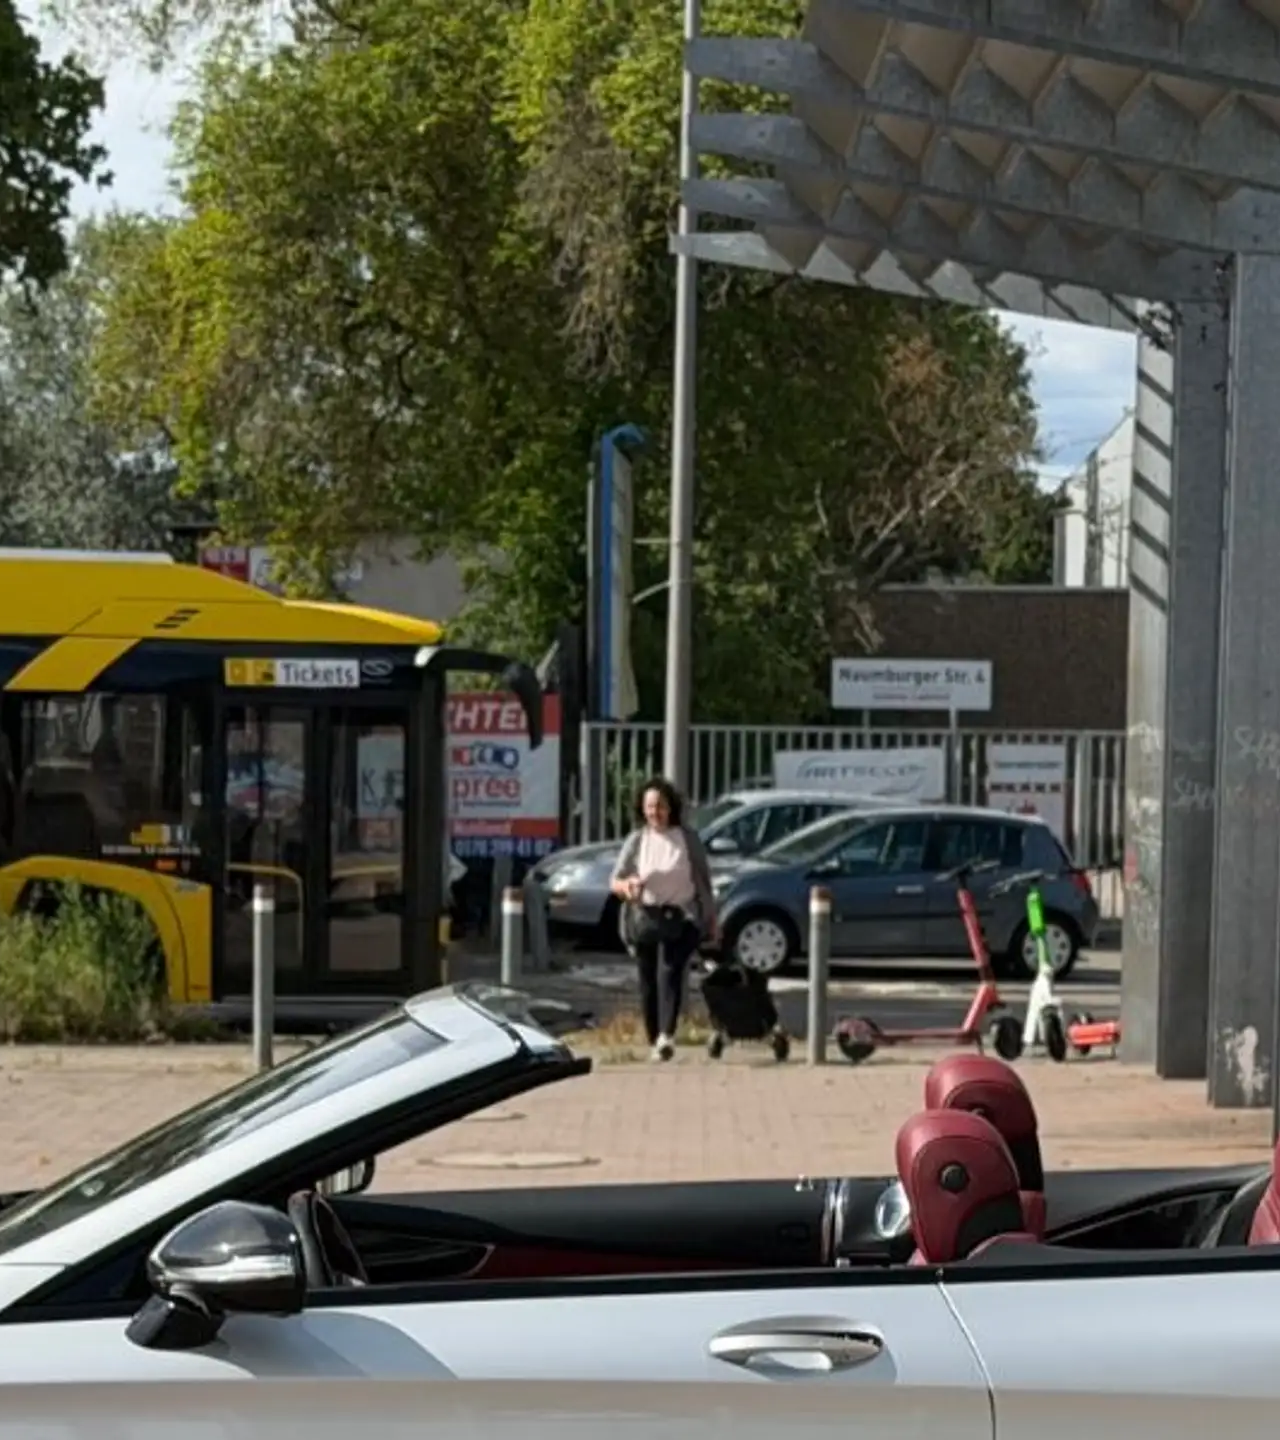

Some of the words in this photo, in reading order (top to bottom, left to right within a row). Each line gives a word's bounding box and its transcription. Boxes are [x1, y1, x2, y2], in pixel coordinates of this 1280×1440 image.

[279, 661, 356, 685] Tickets
[839, 666, 940, 687] Naumburger
[944, 667, 971, 684] Str.
